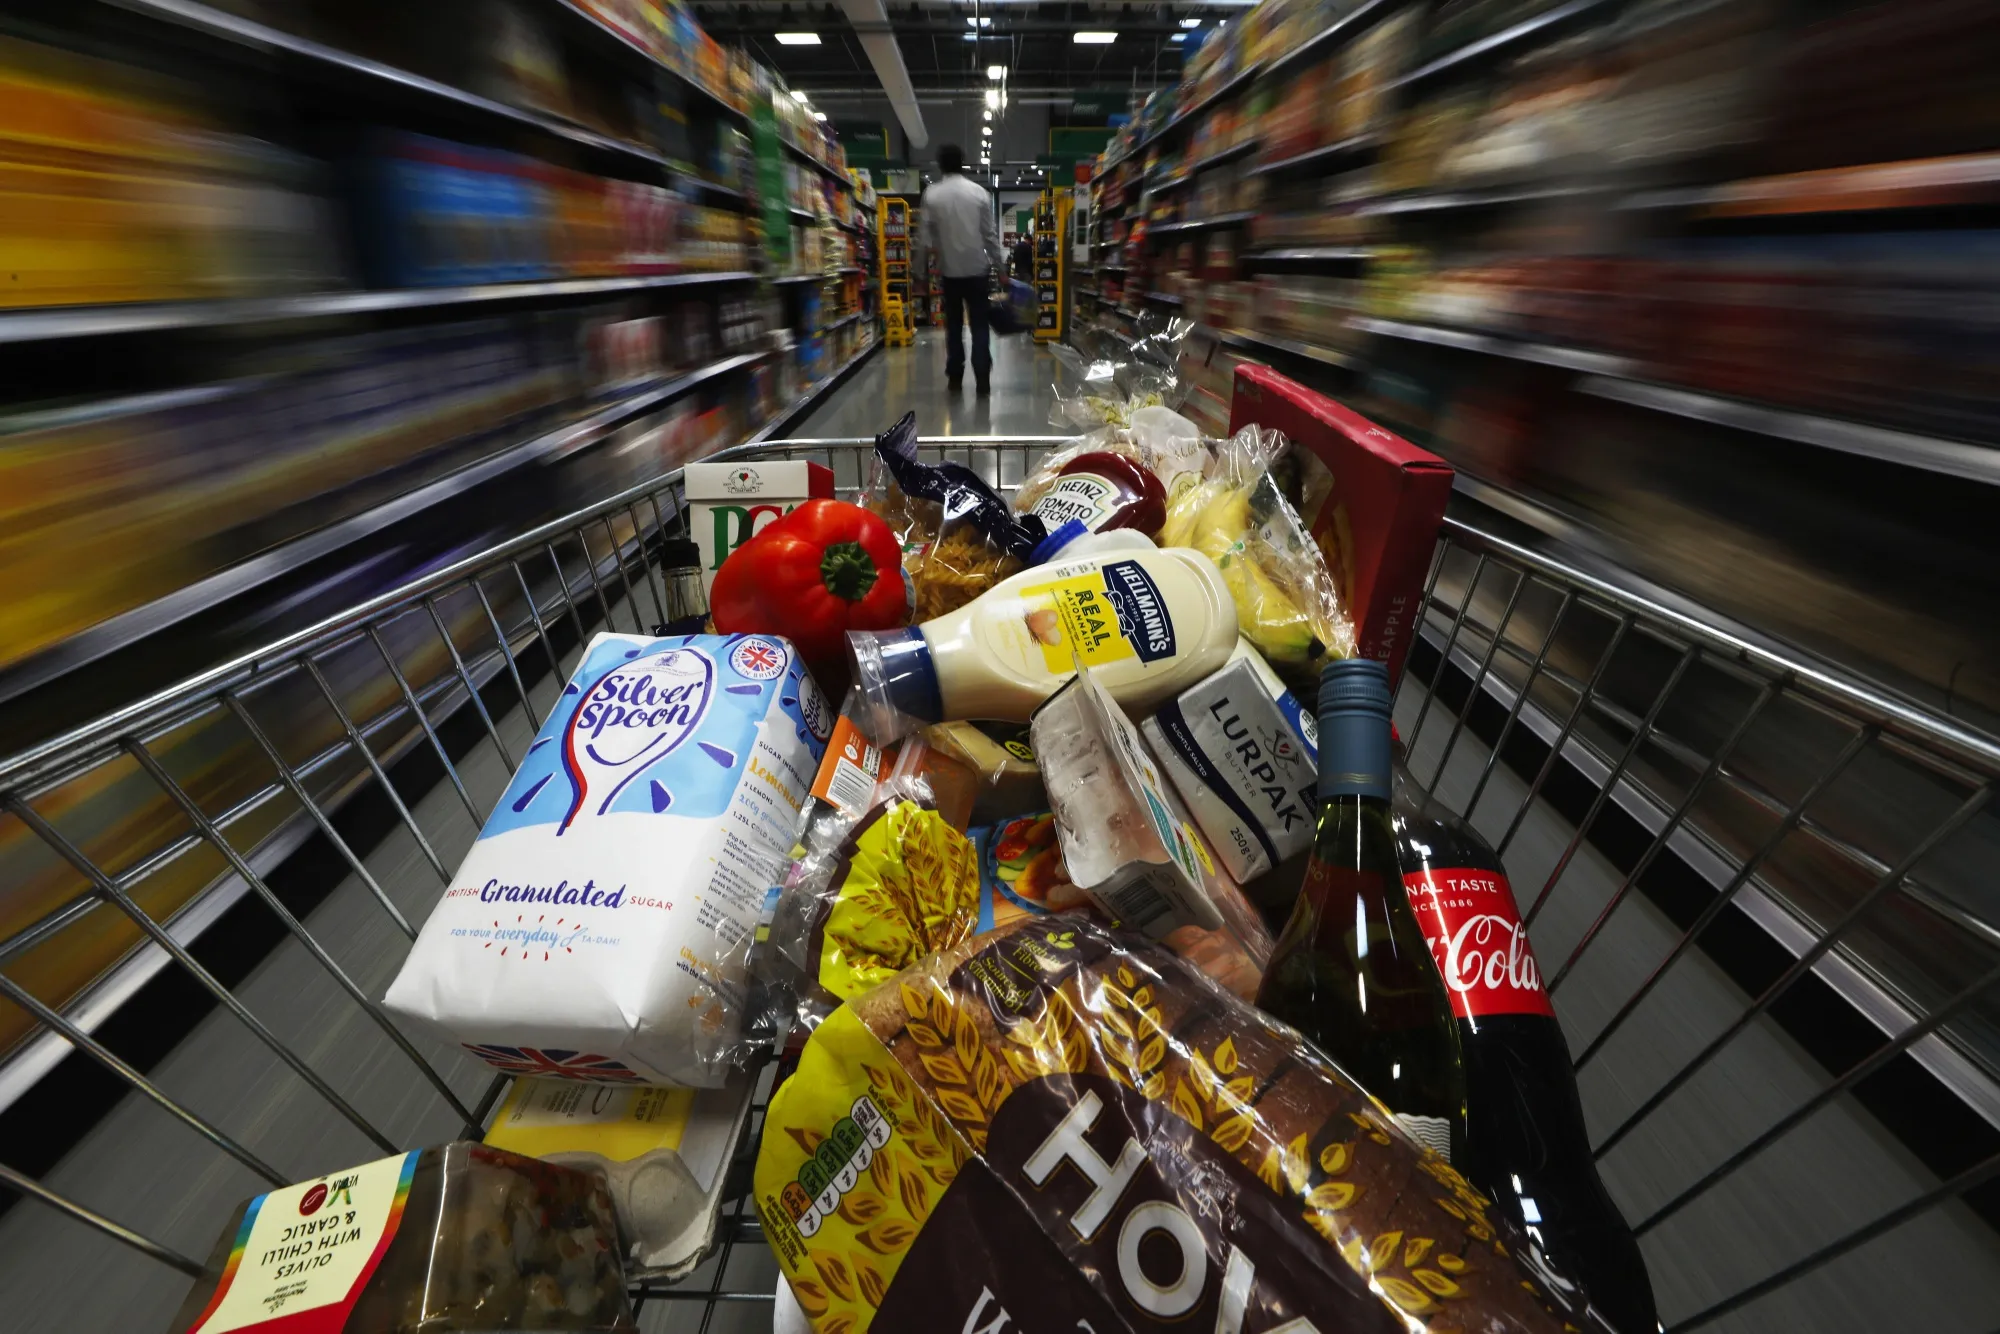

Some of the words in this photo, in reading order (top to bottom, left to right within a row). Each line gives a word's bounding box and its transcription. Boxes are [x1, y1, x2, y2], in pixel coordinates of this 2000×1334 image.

[1058, 480, 1103, 501] HEINZ
[1034, 507, 1076, 525] KETCHU
[1042, 497, 1093, 520] TOMATO
[1075, 590, 1111, 647] REAL
[1116, 565, 1171, 653] HELLMANN'S
[1063, 589, 1095, 654] MAYONNAISE
[1377, 596, 1406, 661] EAPPLE
[751, 639, 784, 659] PROUDLY
[753, 664, 783, 679] BRITAIN
[592, 674, 704, 706] Silver
[1170, 722, 1192, 752] SLIGHTLY
[1190, 751, 1208, 777] SALTED
[758, 740, 782, 761] SUGAR
[782, 758, 808, 791] INSPIRATIO
[1209, 697, 1304, 833] LURPAK
[1224, 751, 1257, 798] BUTTER
[739, 794, 760, 816] 200g
[749, 784, 773, 806] LEMONS
[733, 811, 749, 826] 1.25L
[751, 823, 768, 838] COLD
[737, 839, 748, 848] the
[1230, 827, 1250, 856] 250g
[716, 860, 731, 873] Pour
[728, 869, 739, 879] the
[480, 878, 627, 909] Granulated
[630, 895, 674, 911] SUGAR
[1447, 879, 1498, 894] TASTE
[699, 907, 710, 918] the
[703, 899, 713, 911] Top
[1442, 898, 1473, 910] 1886
[696, 916, 706, 925] ice
[450, 928, 467, 938] FOR
[469, 929, 492, 939] YOUR
[494, 926, 561, 948] everyday
[581, 934, 621, 946] TA-DAH!
[1012, 946, 1044, 973] Fibre
[1444, 914, 1540, 992] Cola
[676, 960, 690, 976] with
[981, 957, 1018, 991] Source
[1017, 989, 1033, 1001] of
[967, 959, 1006, 999] Vitamin
[1004, 994, 1026, 1014] B1
[873, 1126, 885, 1144] 5%
[858, 1149, 868, 1166] 1%
[330, 1174, 360, 1194] VEGAN
[841, 1170, 852, 1188] 1%
[822, 1192, 833, 1210] 2%
[343, 1210, 357, 1224] &
[804, 1213, 815, 1232] 7%
[280, 1215, 339, 1242] GARLIC
[318, 1226, 361, 1249] WITH
[260, 1241, 313, 1266] CHILLI
[274, 1252, 333, 1280] OLIVES
